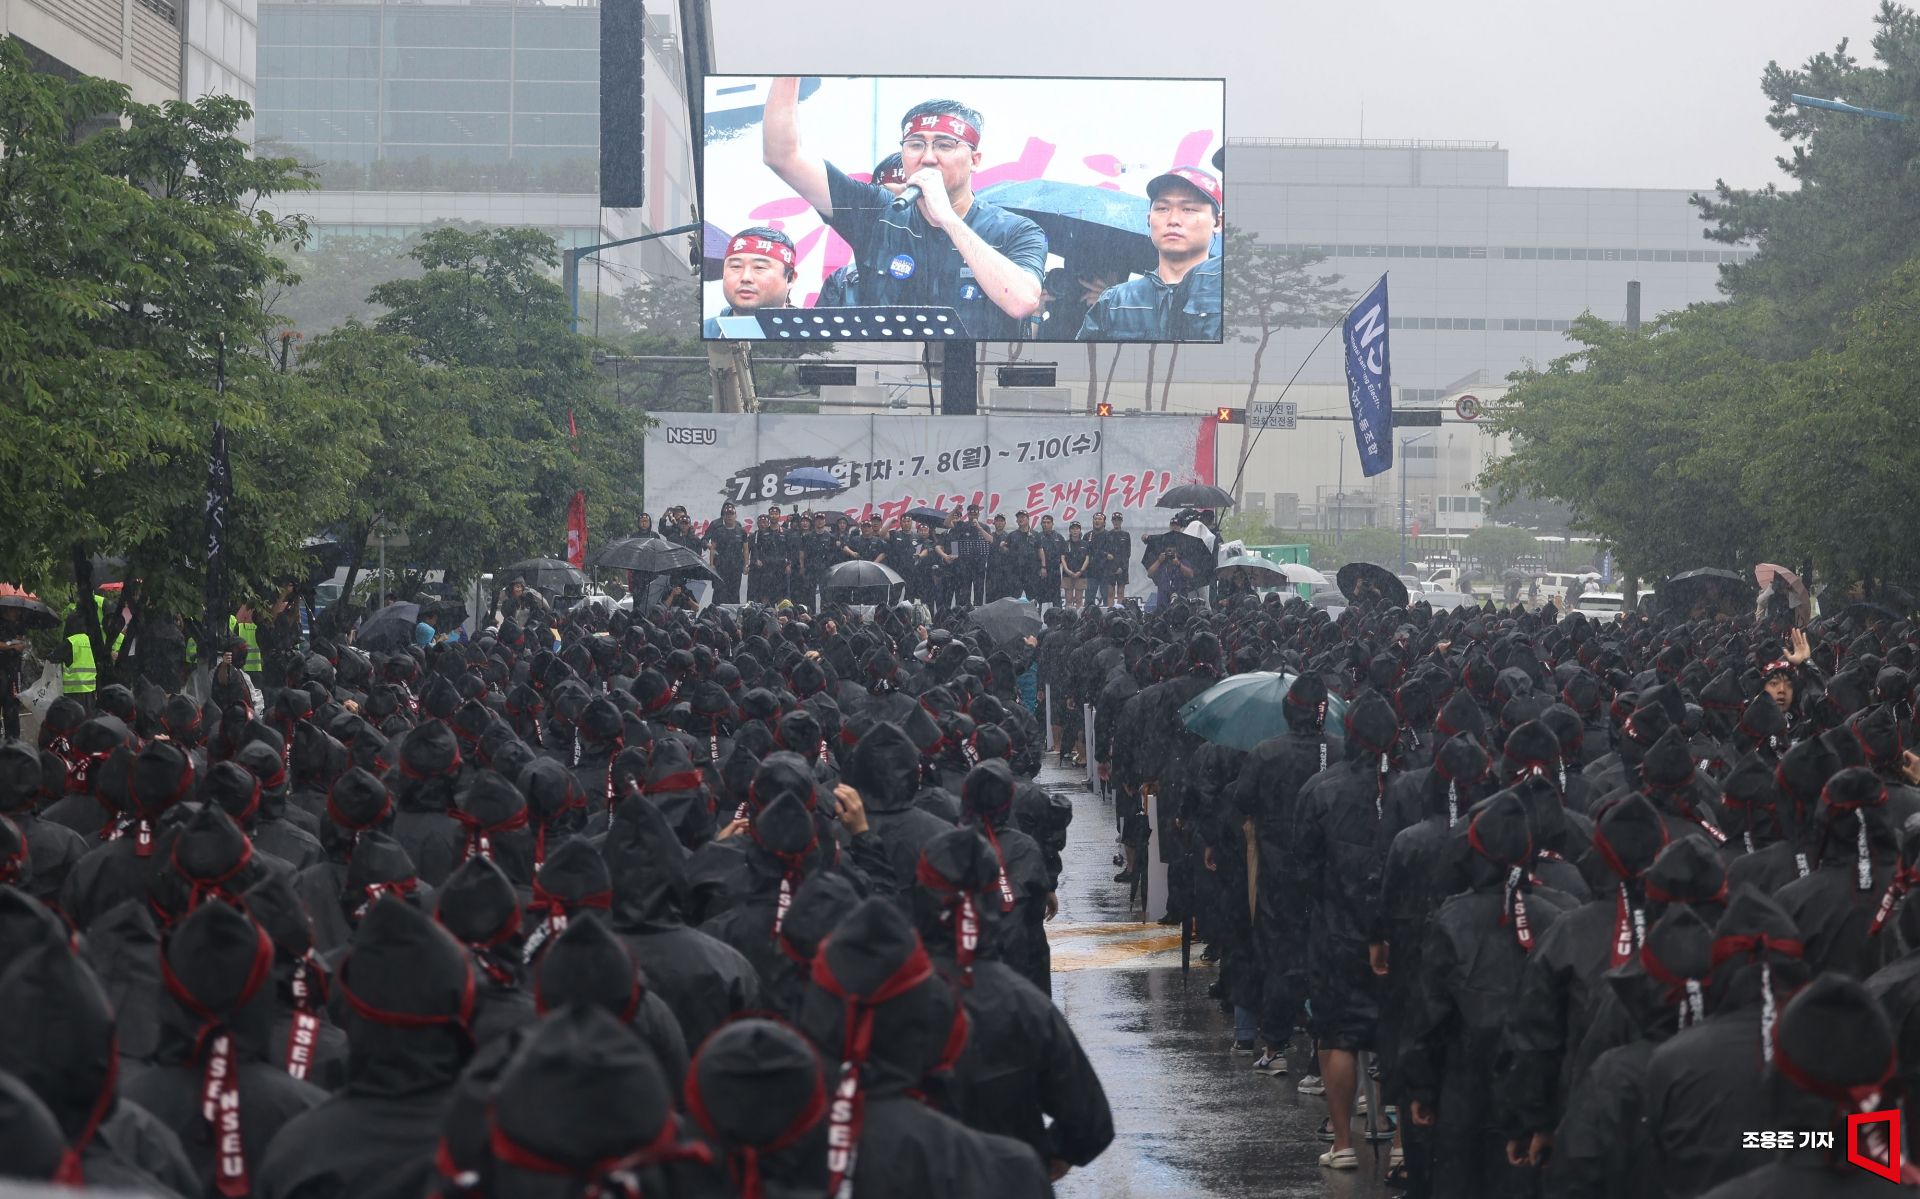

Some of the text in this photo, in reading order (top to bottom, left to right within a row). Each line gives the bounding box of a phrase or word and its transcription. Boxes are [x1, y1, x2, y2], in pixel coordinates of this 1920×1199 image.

[667, 427, 717, 445] NSEU
[709, 735, 719, 763] NSE
[288, 1013, 316, 1080] NSEU
[218, 1088, 244, 1177] NSEU
